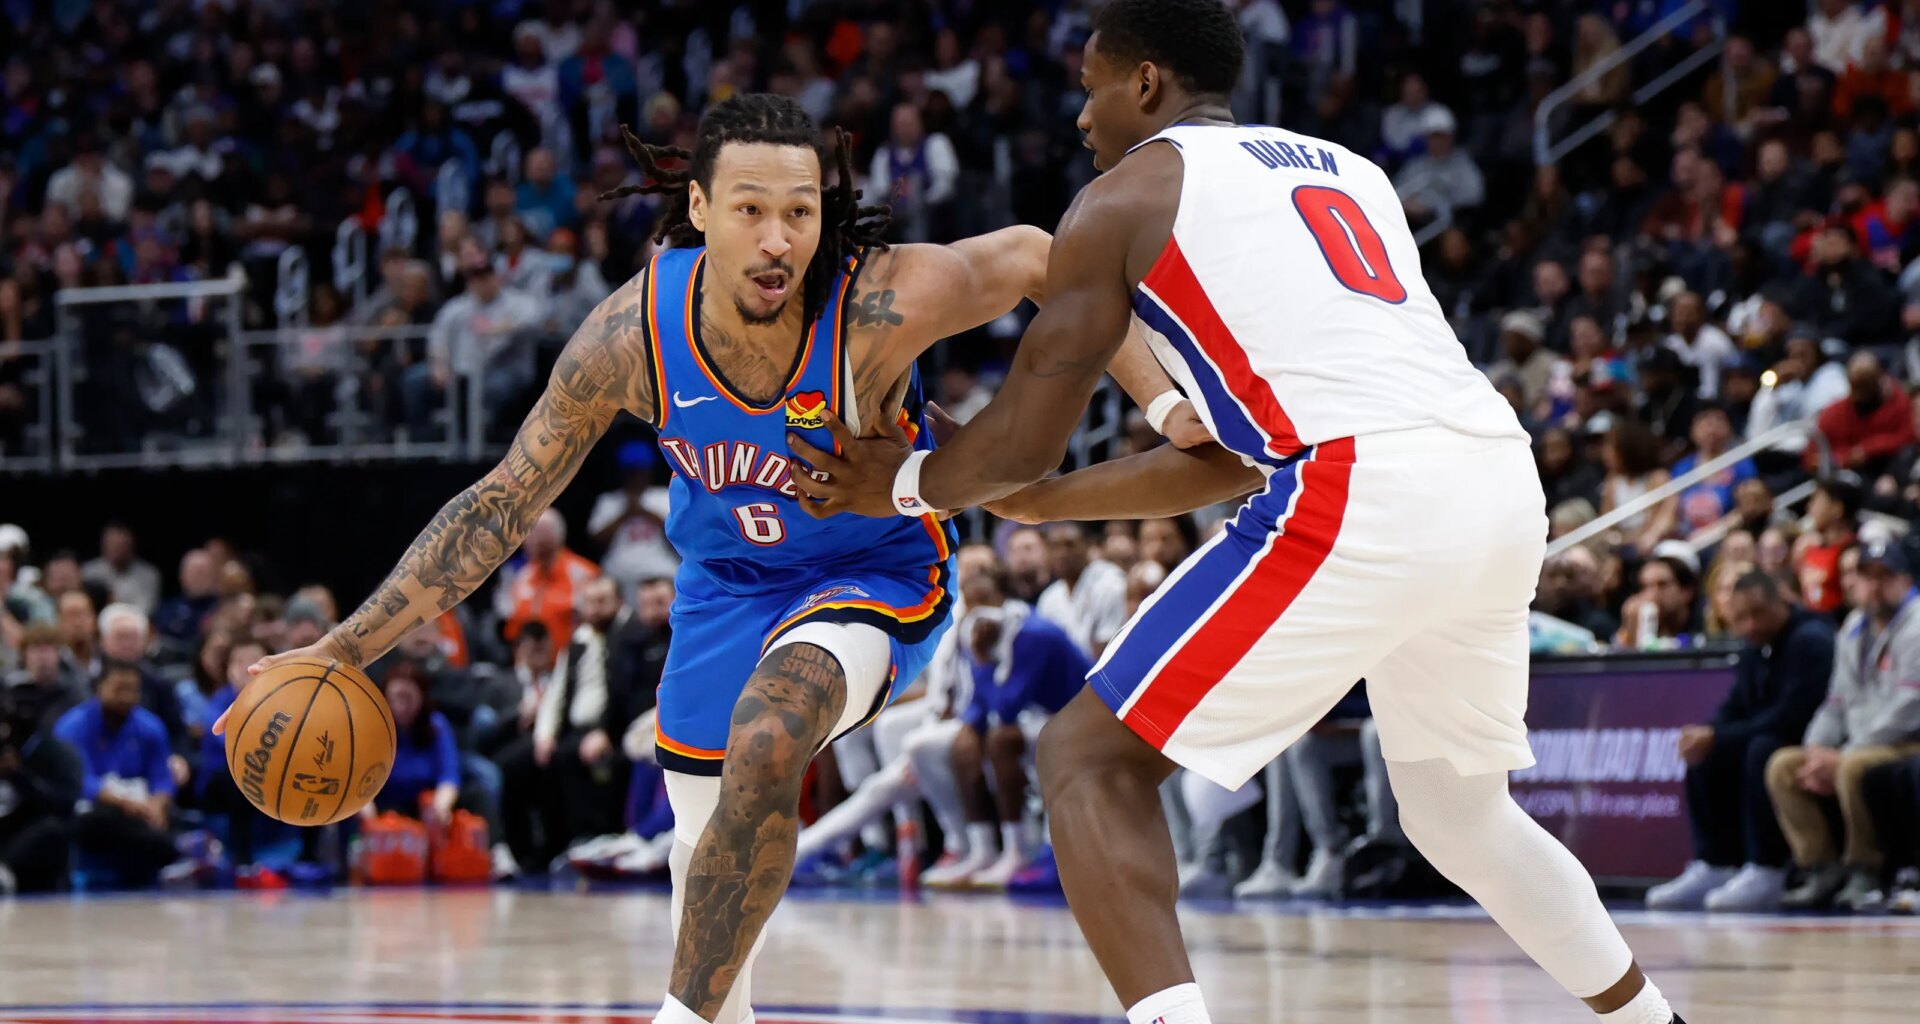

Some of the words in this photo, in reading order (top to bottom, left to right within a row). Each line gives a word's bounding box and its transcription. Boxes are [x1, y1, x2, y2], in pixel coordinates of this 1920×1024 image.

[1238, 140, 1340, 176] DUREN
[1291, 185, 1407, 304] 0
[733, 502, 785, 550] 6
[242, 711, 294, 806] Wilson
